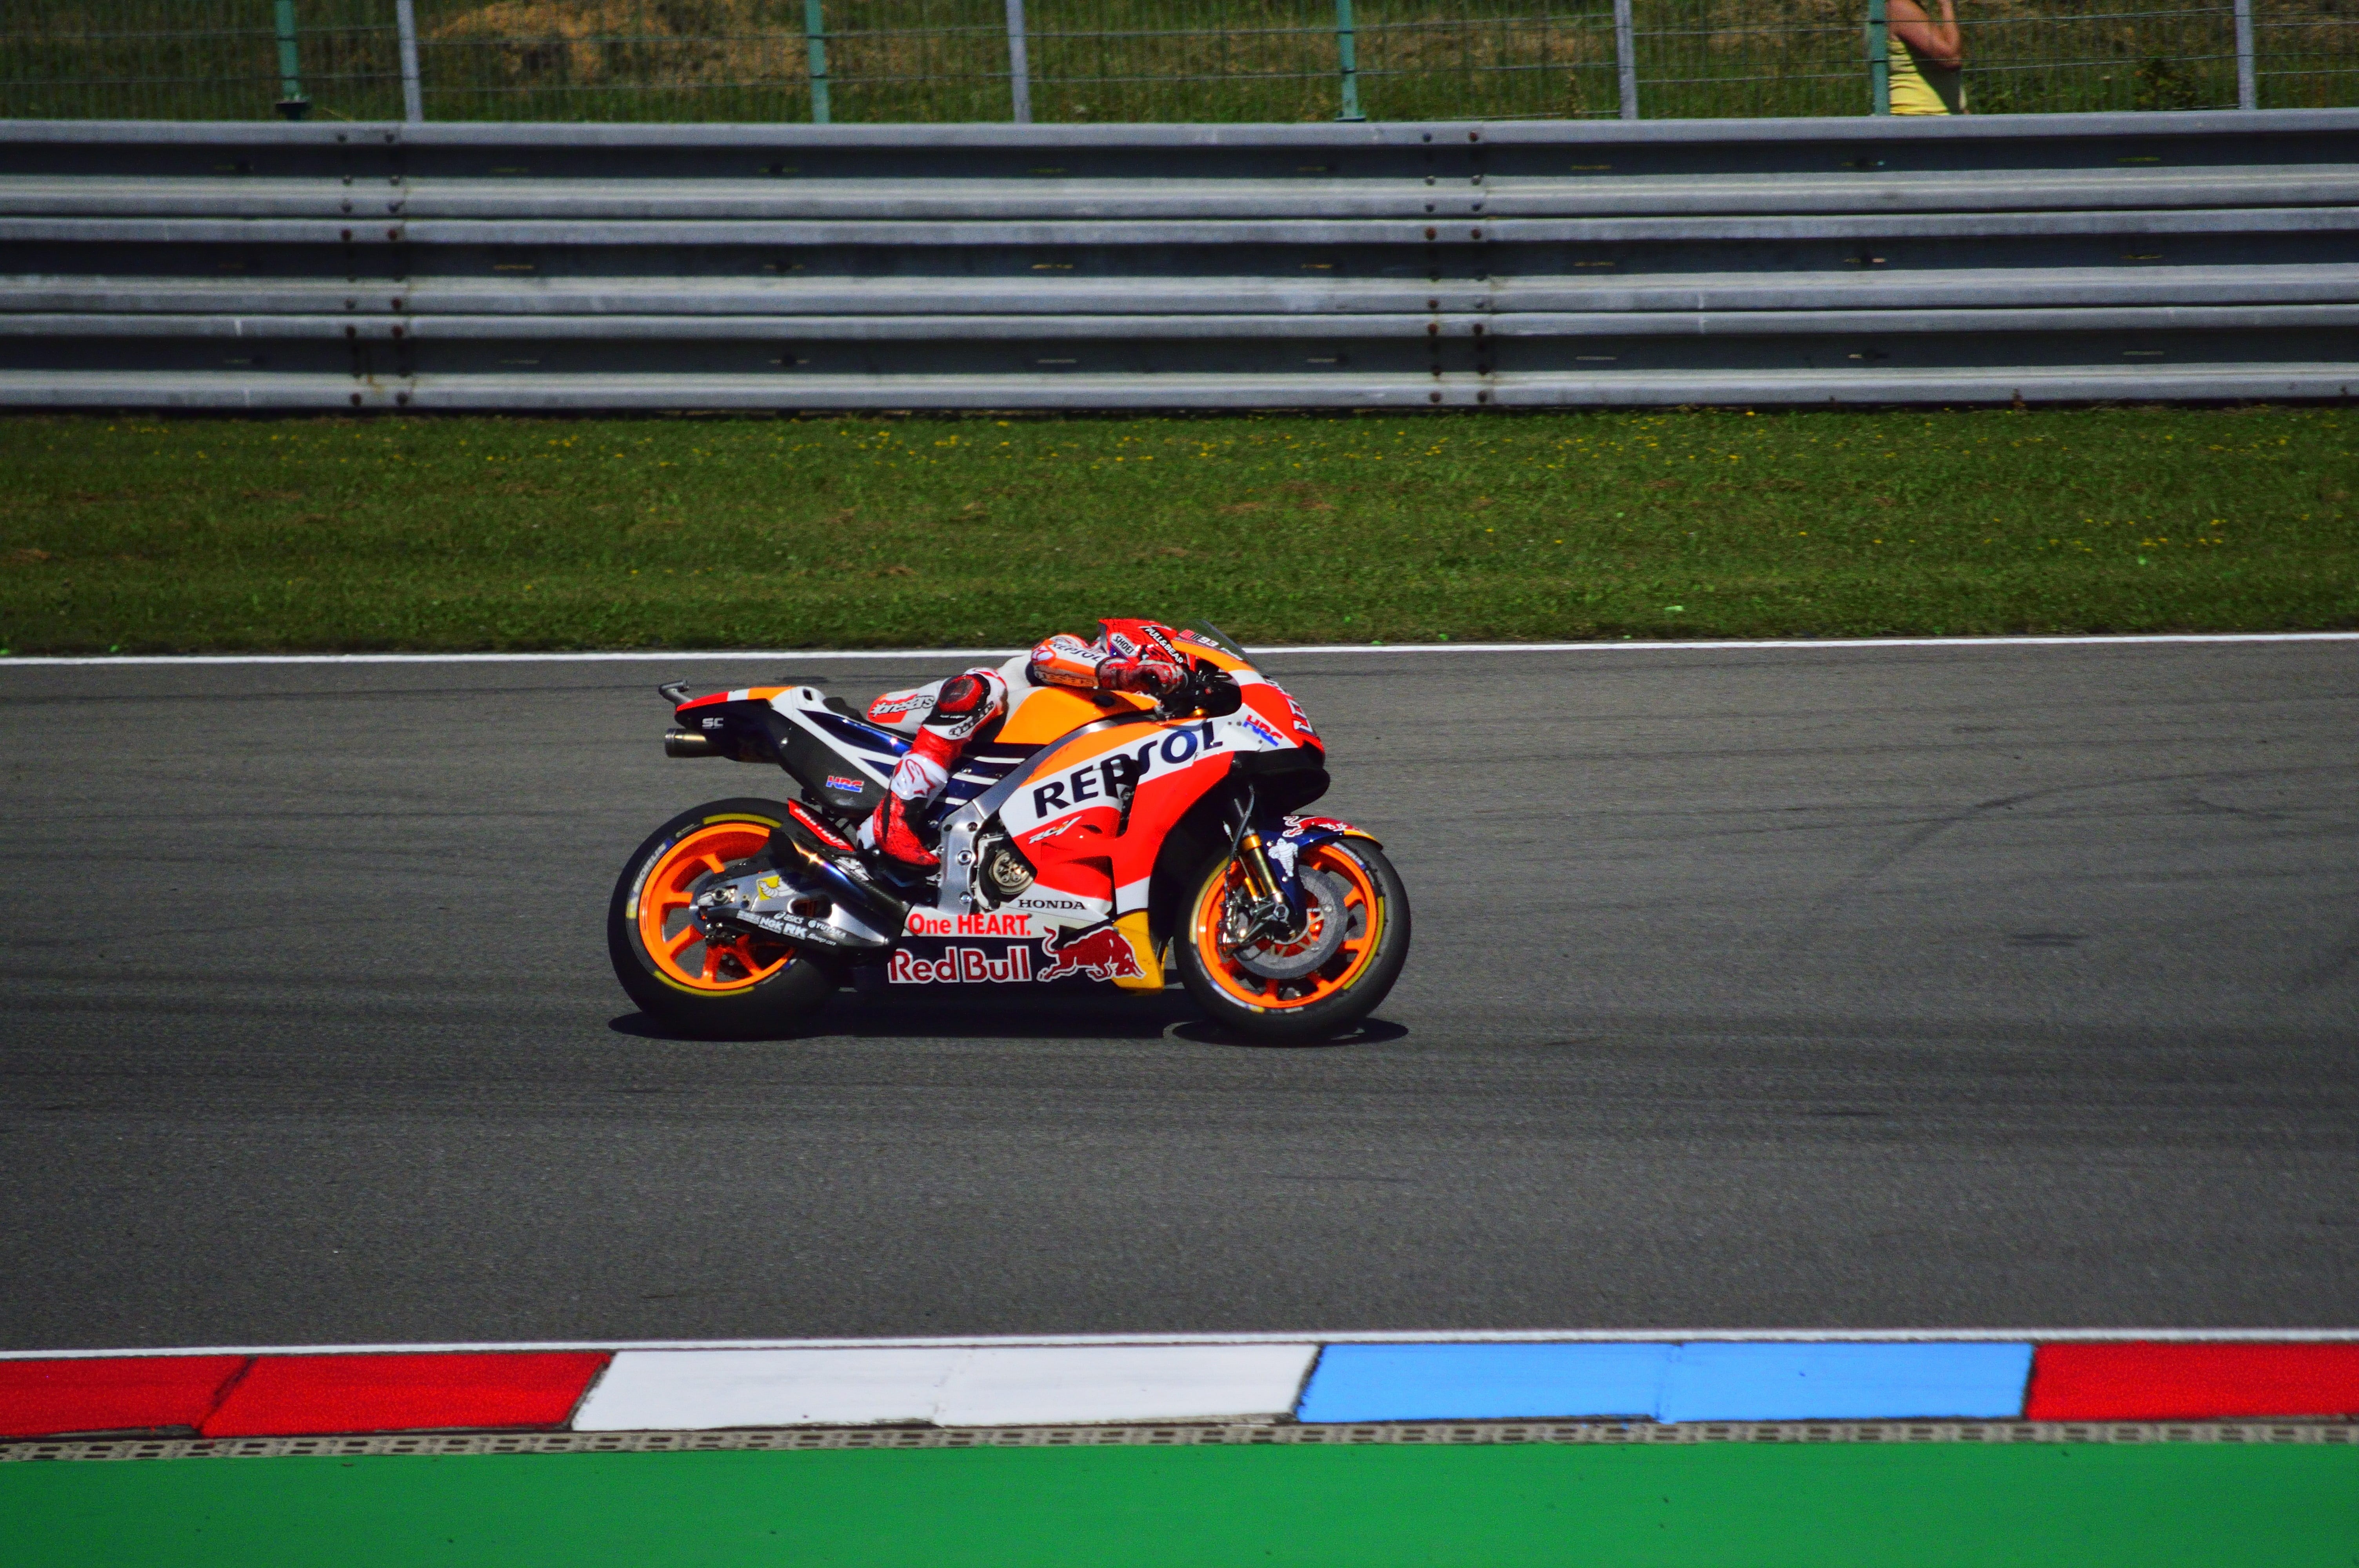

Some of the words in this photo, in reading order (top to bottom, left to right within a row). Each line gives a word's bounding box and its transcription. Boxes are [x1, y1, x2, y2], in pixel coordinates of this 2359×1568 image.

[1113, 635, 1134, 654] SHOEI
[1145, 628, 1183, 663] PULL&BEAR
[1198, 637, 1219, 647] 93
[702, 717, 724, 727] SC
[1242, 715, 1283, 747] HRC
[1033, 721, 1223, 818] REPSOL
[826, 775, 864, 793] HRC
[1019, 900, 1087, 910] HONDA
[760, 917, 784, 931] NGK
[784, 923, 808, 938] RK
[816, 923, 847, 939] YUTAKA
[908, 913, 951, 935] One
[957, 913, 1031, 936] HEART.
